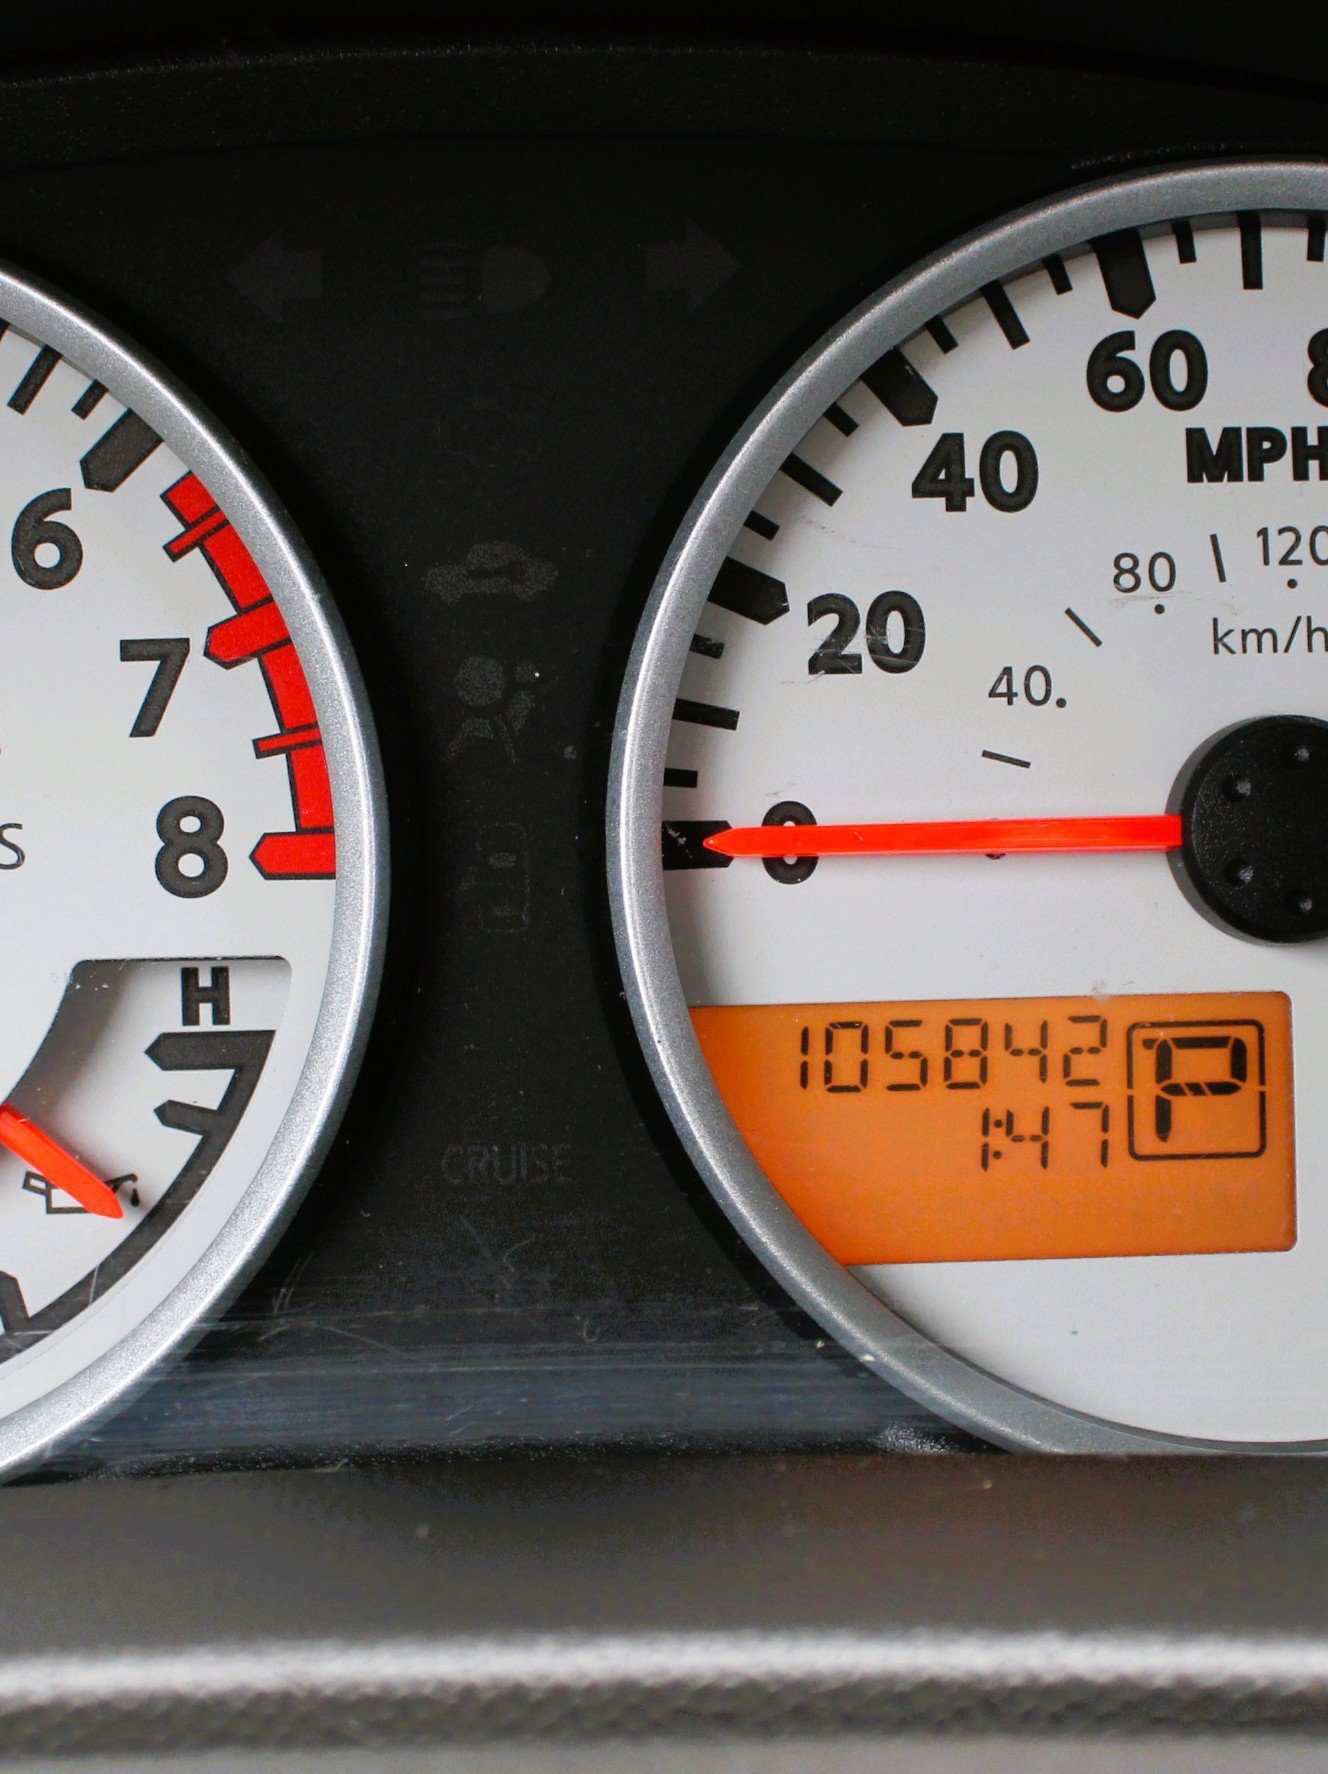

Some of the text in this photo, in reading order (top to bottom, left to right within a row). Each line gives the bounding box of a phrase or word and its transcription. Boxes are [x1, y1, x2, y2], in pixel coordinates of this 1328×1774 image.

[1087, 330, 1208, 412] 60
[912, 431, 1038, 512] 40
[12, 488, 83, 590] 6
[1114, 552, 1176, 593] 80
[807, 591, 925, 675] 20
[120, 638, 190, 738] 7
[989, 665, 1052, 706] 40
[155, 796, 228, 898] 8
[761, 801, 819, 885] 0
[181, 965, 230, 1026] H
[799, 1015, 1108, 1093] 105842
[1143, 1036, 1248, 1143] P
[980, 1102, 1110, 1172] 1:47
